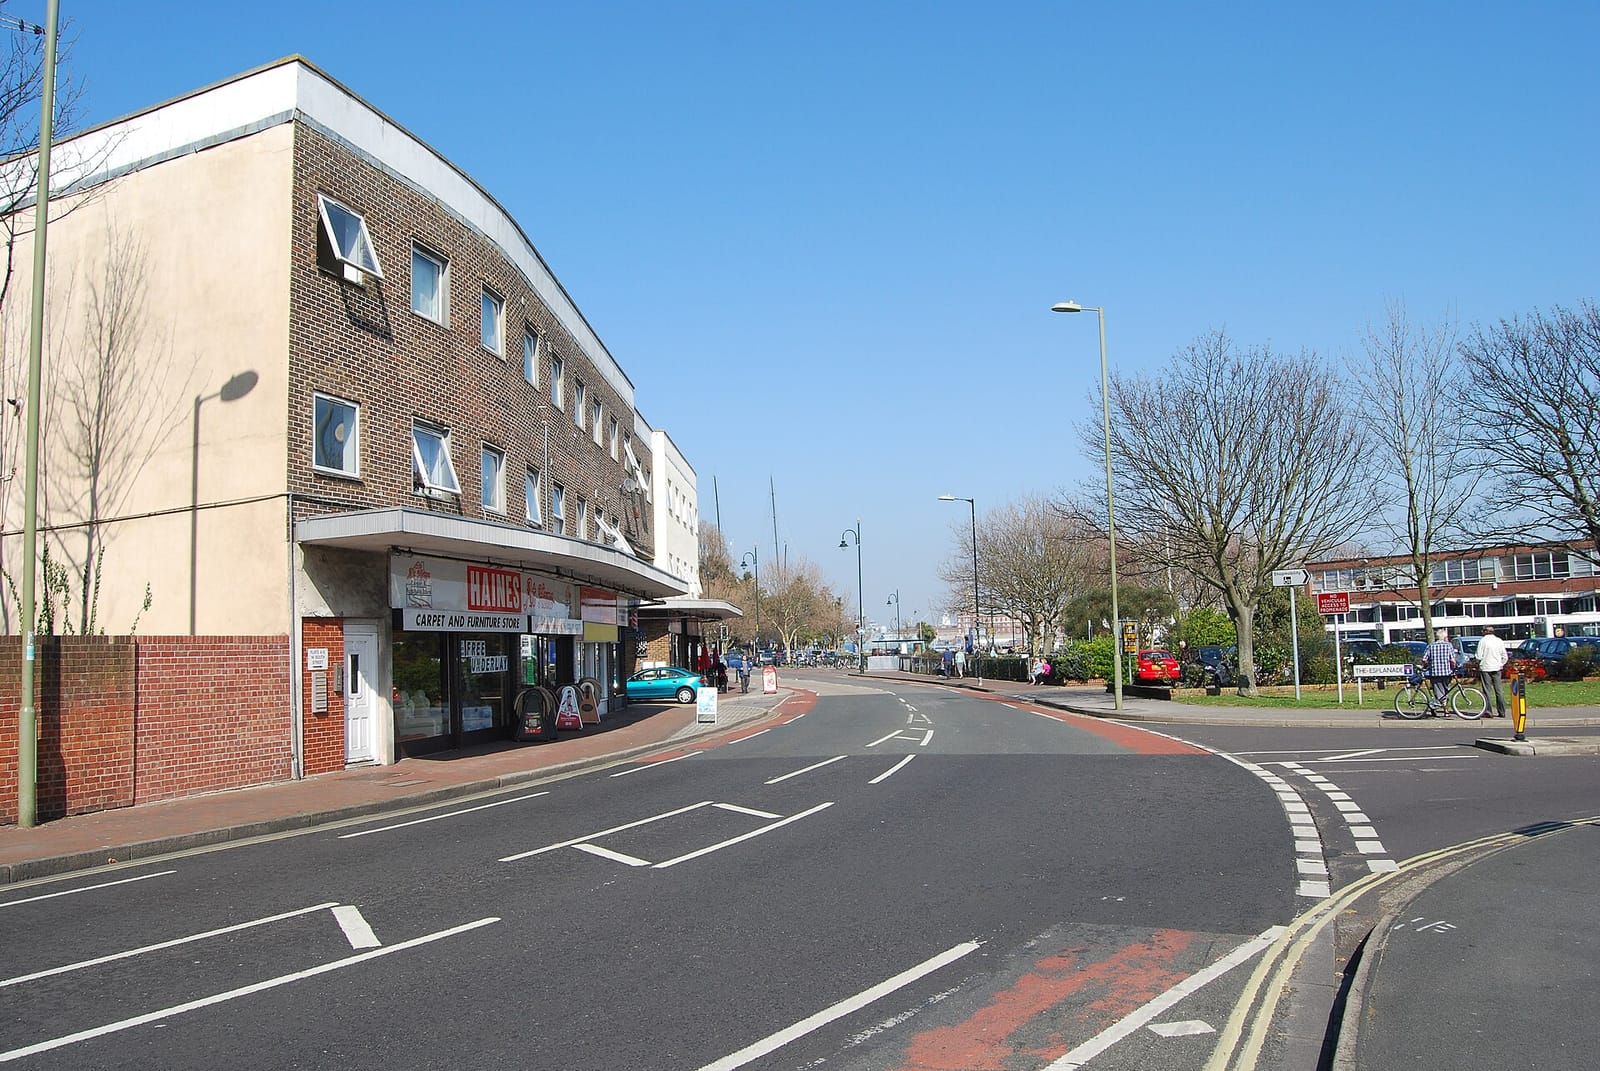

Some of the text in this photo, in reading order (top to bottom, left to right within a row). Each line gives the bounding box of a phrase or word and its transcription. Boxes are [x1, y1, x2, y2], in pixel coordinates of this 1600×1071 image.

[470, 570, 520, 609] HAINES
[416, 614, 446, 627] CARPET
[448, 615, 465, 627] AND
[467, 616, 501, 628] FURNITURE
[502, 617, 520, 629] STORE
[467, 641, 486, 656] FREE
[471, 656, 508, 673] UNDERLAY
